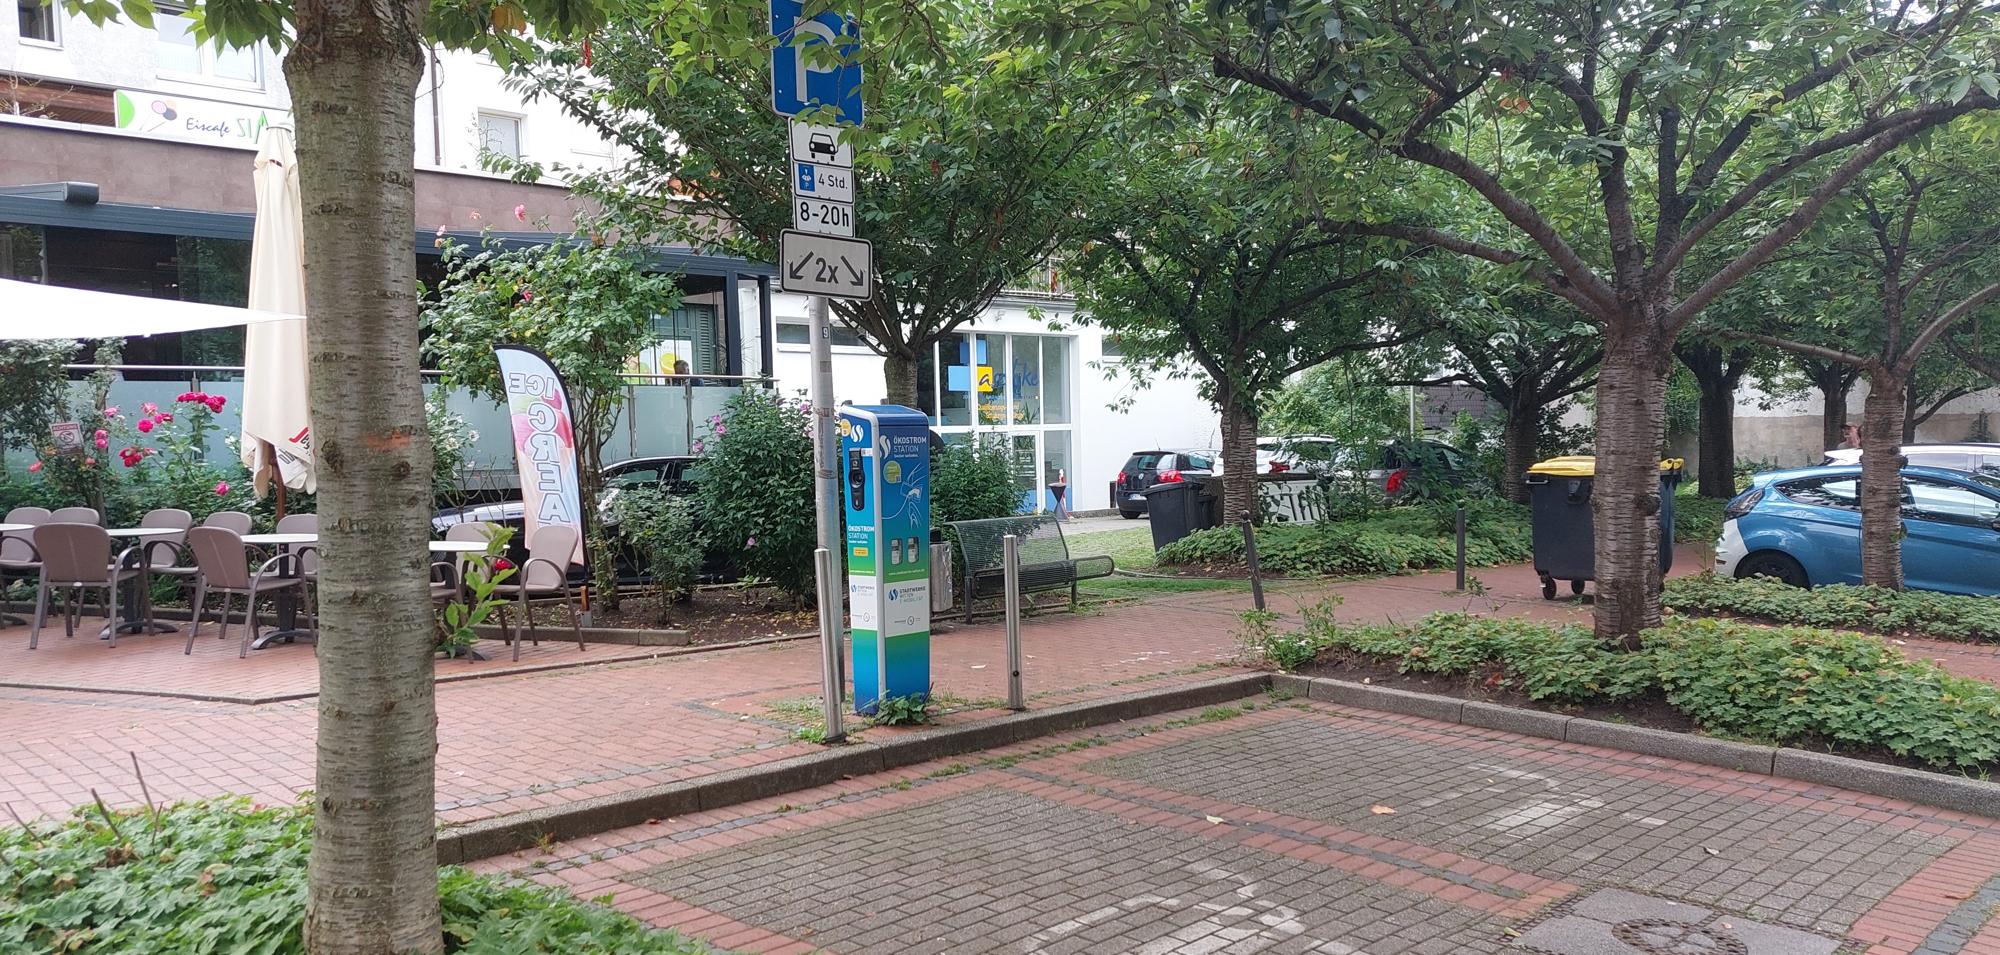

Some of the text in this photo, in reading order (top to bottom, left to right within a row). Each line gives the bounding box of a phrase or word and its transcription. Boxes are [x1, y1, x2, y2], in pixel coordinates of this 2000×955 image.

[794, 16, 838, 103] P
[186, 118, 232, 137] Eiscafe
[818, 173, 848, 189] 4 Std.
[800, 201, 850, 227] 8-20h
[815, 257, 839, 285] 2x
[893, 434, 927, 445] ÖKOSTROM
[893, 445, 919, 453] STATION
